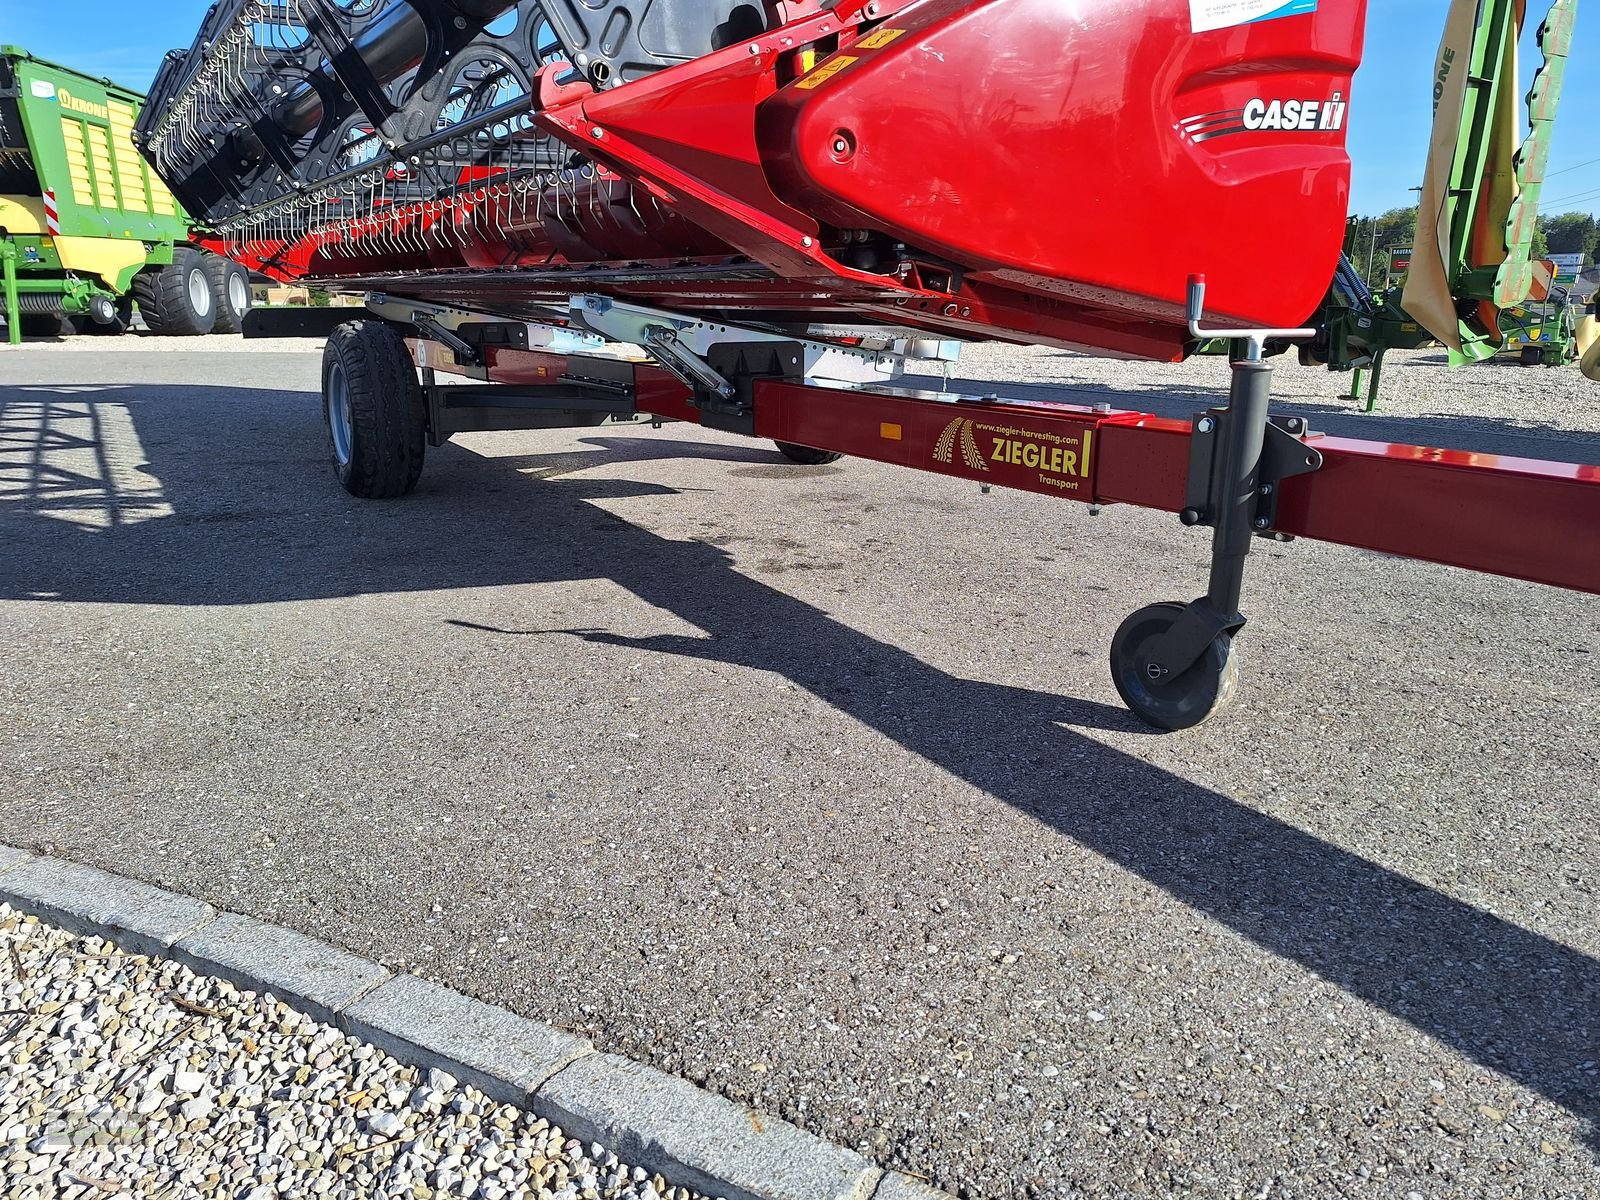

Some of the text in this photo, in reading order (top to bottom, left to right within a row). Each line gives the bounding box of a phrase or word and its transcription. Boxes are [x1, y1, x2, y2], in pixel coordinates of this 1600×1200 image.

[72, 97, 108, 119] KRONE
[1243, 98, 1319, 130] CASE
[976, 423, 1079, 446] www.ziegler-harvesting.com
[991, 437, 1077, 476] ZIEGLER
[1039, 473, 1079, 490] Transport
